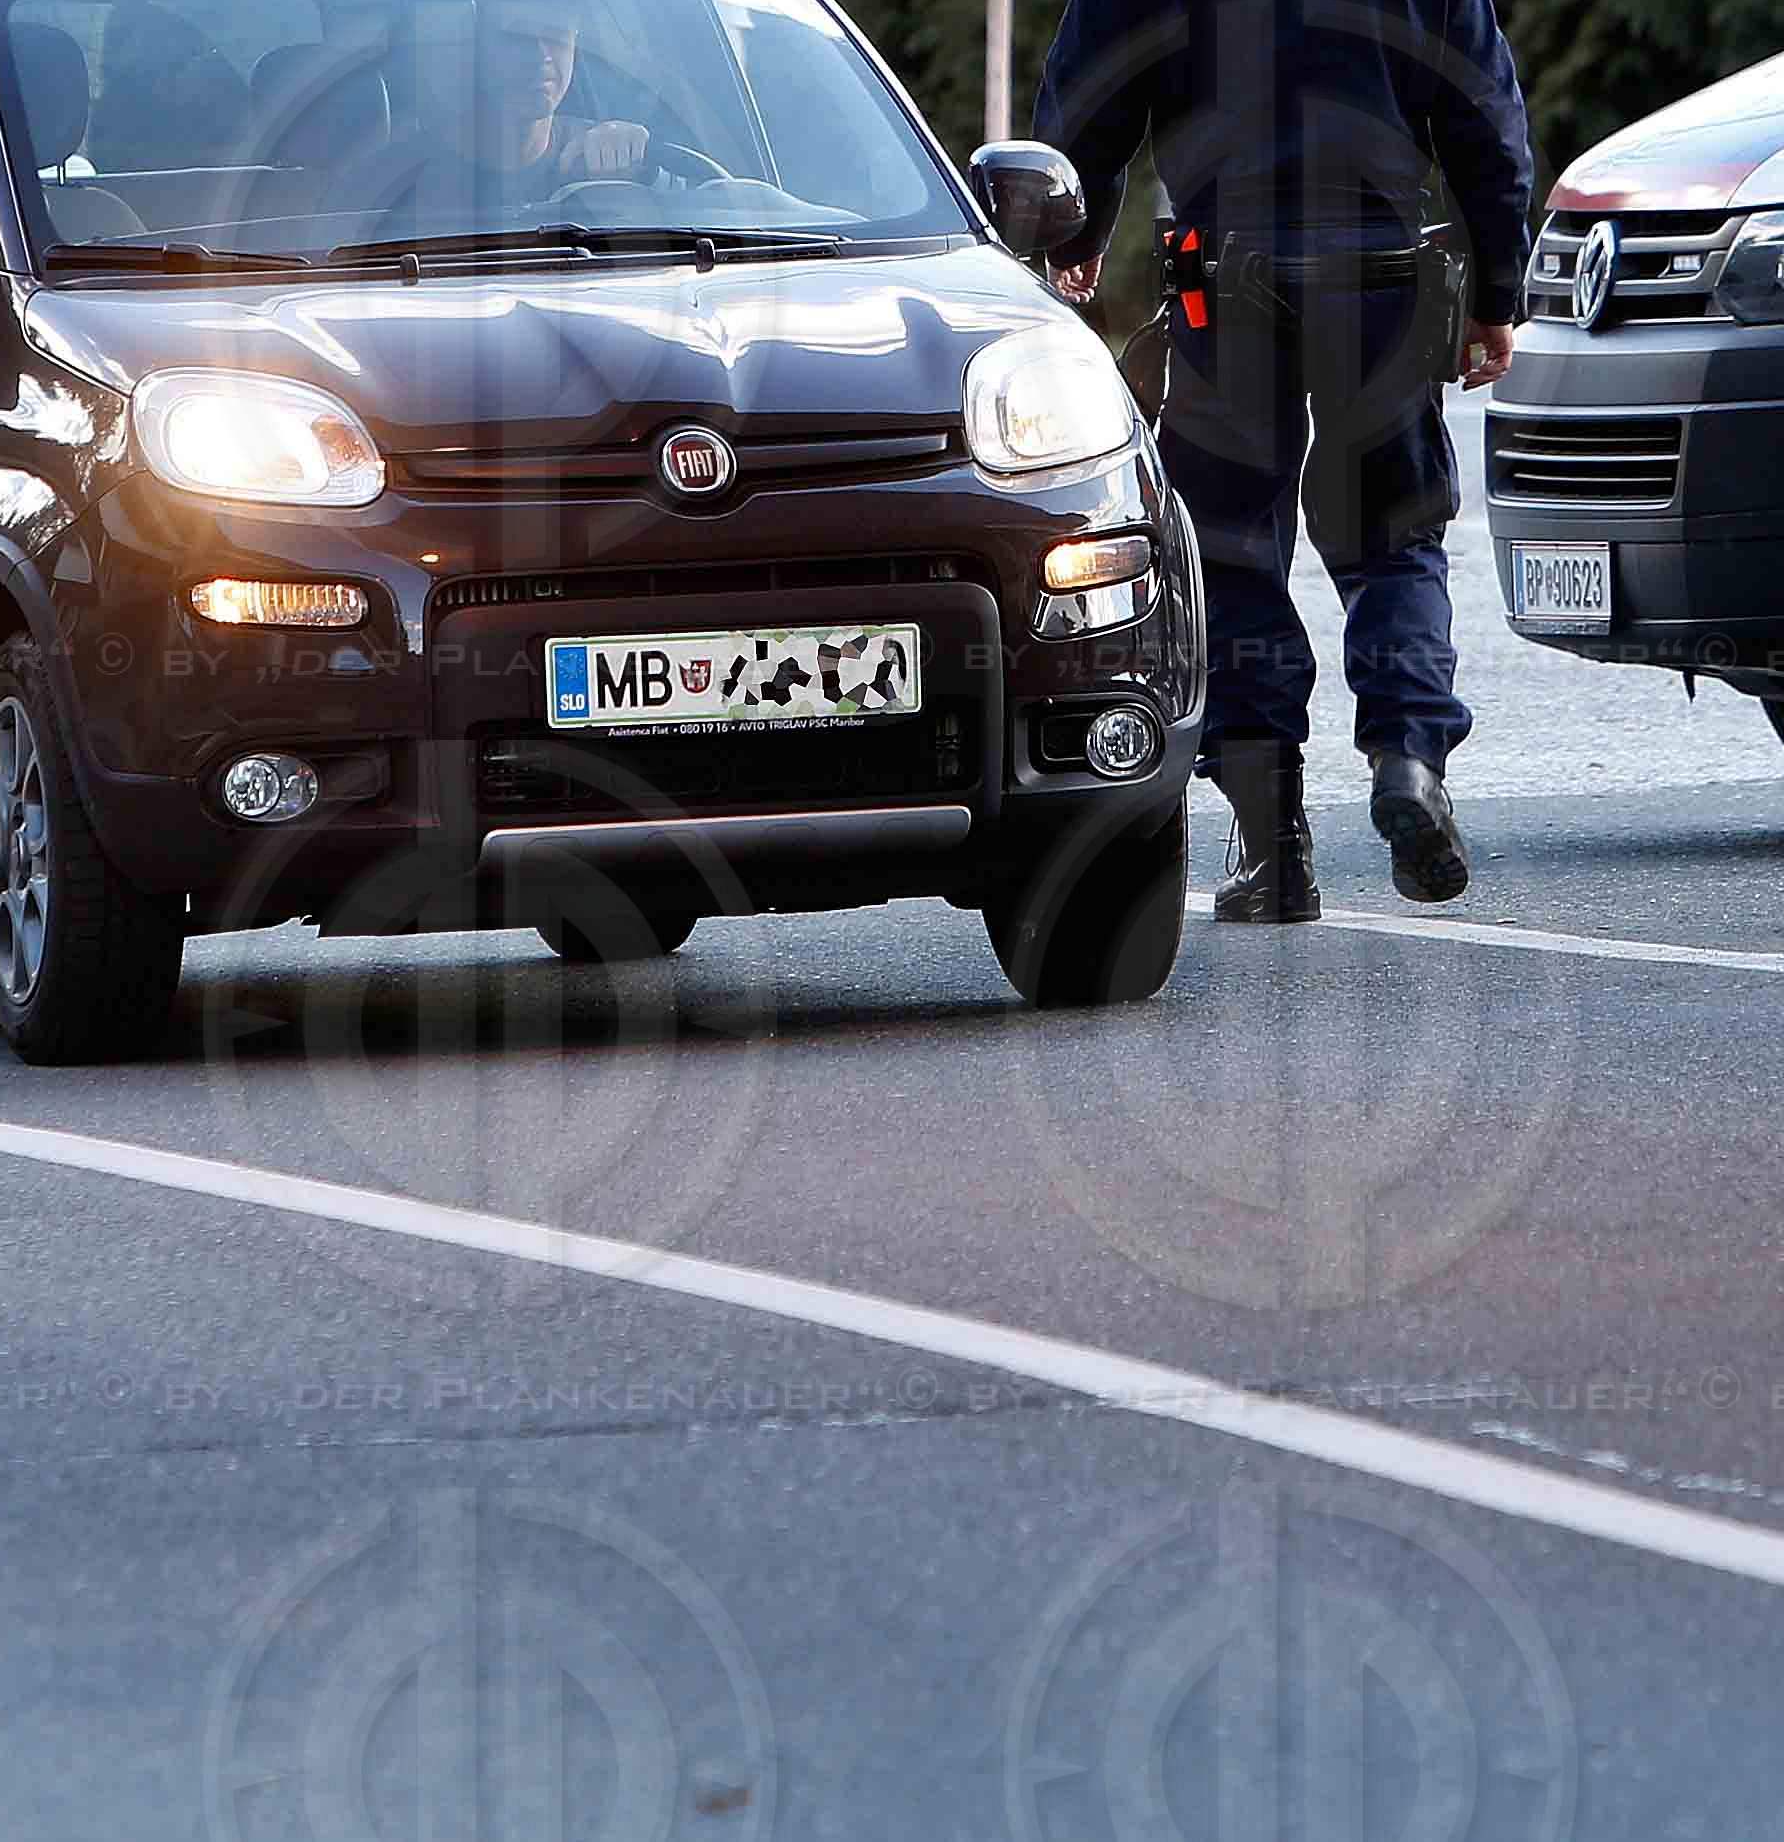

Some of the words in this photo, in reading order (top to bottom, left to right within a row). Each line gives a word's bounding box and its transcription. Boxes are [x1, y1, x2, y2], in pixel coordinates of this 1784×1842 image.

[676, 447, 714, 480] FIAT
[1525, 557, 1544, 607] BP
[1552, 557, 1603, 608] 90623
[595, 648, 673, 709] MB
[560, 694, 585, 712] SLO
[702, 723, 715, 734] 19
[739, 721, 765, 732] AVTO
[809, 718, 828, 729] PSC
